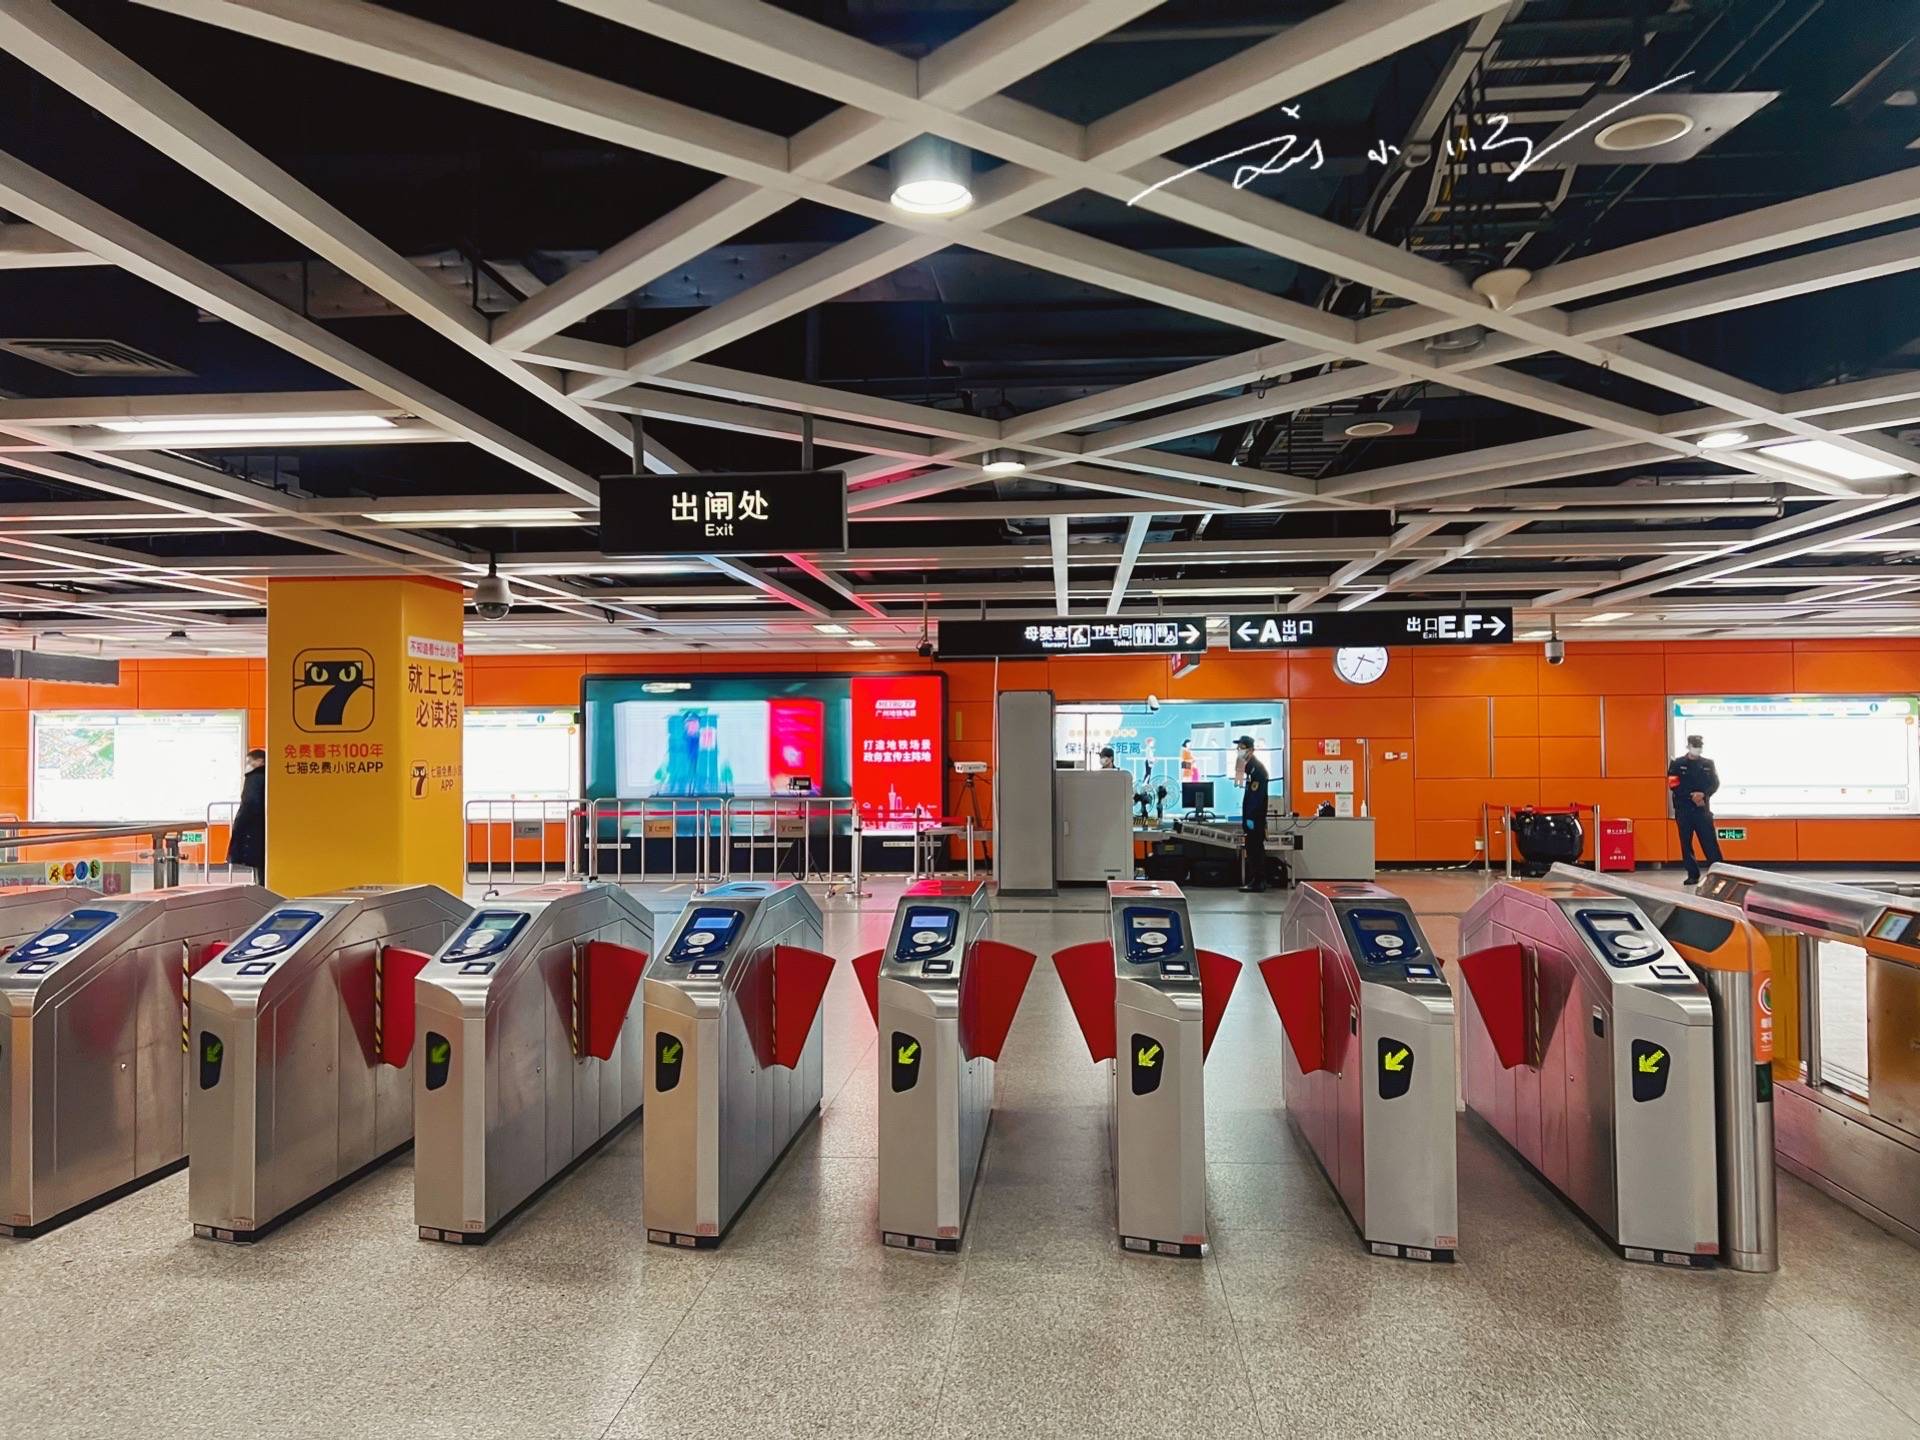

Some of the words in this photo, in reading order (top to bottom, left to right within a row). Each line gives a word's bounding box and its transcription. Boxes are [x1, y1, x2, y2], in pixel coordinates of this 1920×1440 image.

[672, 490, 769, 522] 出闸处
[705, 523, 734, 536] Exit
[1091, 624, 1133, 640] 卫生间
[1259, 619, 1282, 643] A
[1282, 619, 1313, 634] 出口
[1406, 616, 1437, 632] 出口
[1438, 615, 1482, 638] E.F
[1024, 625, 1068, 642] 母婴室
[1423, 631, 1437, 640] Exit
[1113, 639, 1133, 647] Toilet
[408, 663, 463, 697] 就上七猫
[416, 700, 458, 728] 必读榜
[284, 743, 384, 758] 免费看书100年
[284, 761, 384, 774] 七猫免费小说APP
[1307, 764, 1349, 775] 消火栓
